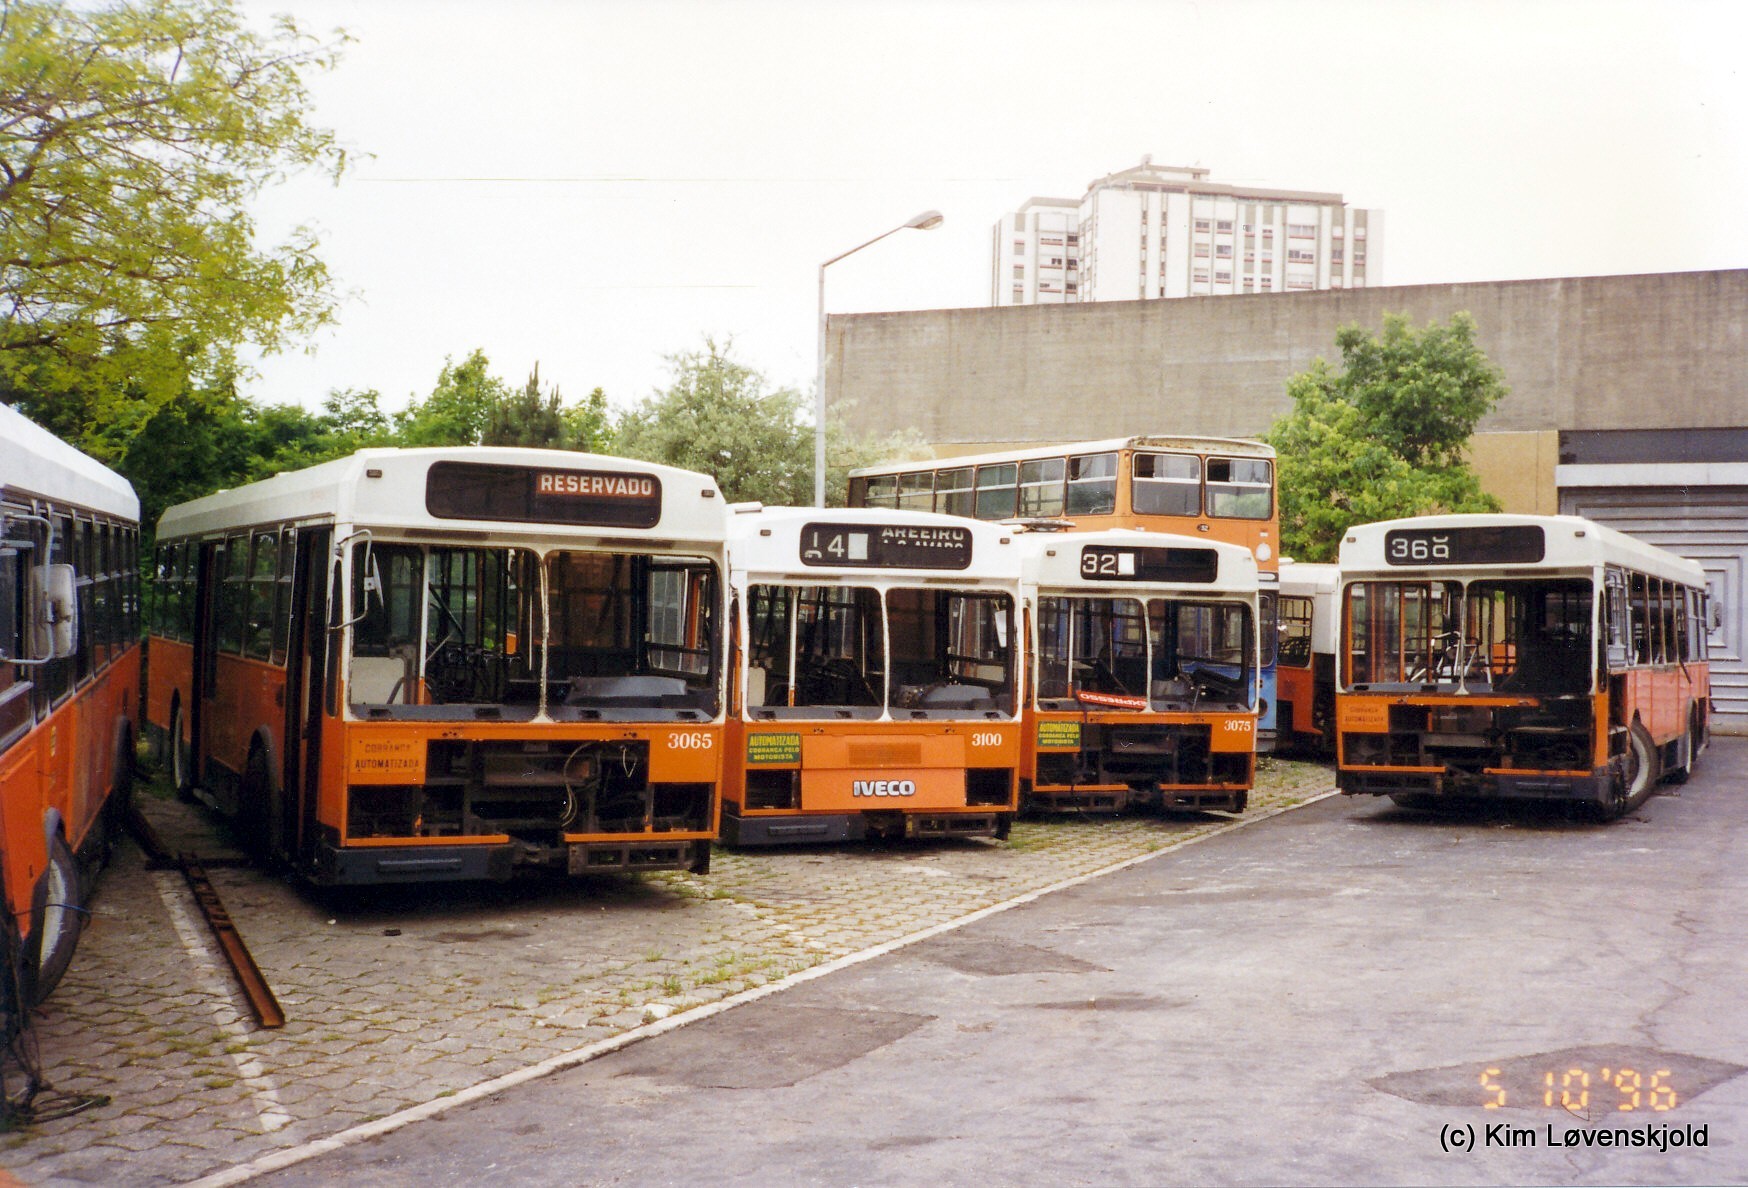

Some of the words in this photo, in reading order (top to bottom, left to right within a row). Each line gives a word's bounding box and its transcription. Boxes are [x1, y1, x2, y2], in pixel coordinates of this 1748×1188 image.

[541, 473, 652, 496] RESERVADO
[1082, 553, 1116, 576] 32
[1224, 719, 1251, 732] 3075
[668, 732, 713, 749] 3065
[749, 735, 800, 747] AUTOMATIZADA
[971, 733, 1003, 747] 3100
[355, 759, 419, 769] AUTOMATIZADA
[853, 780, 916, 797] IVECO
